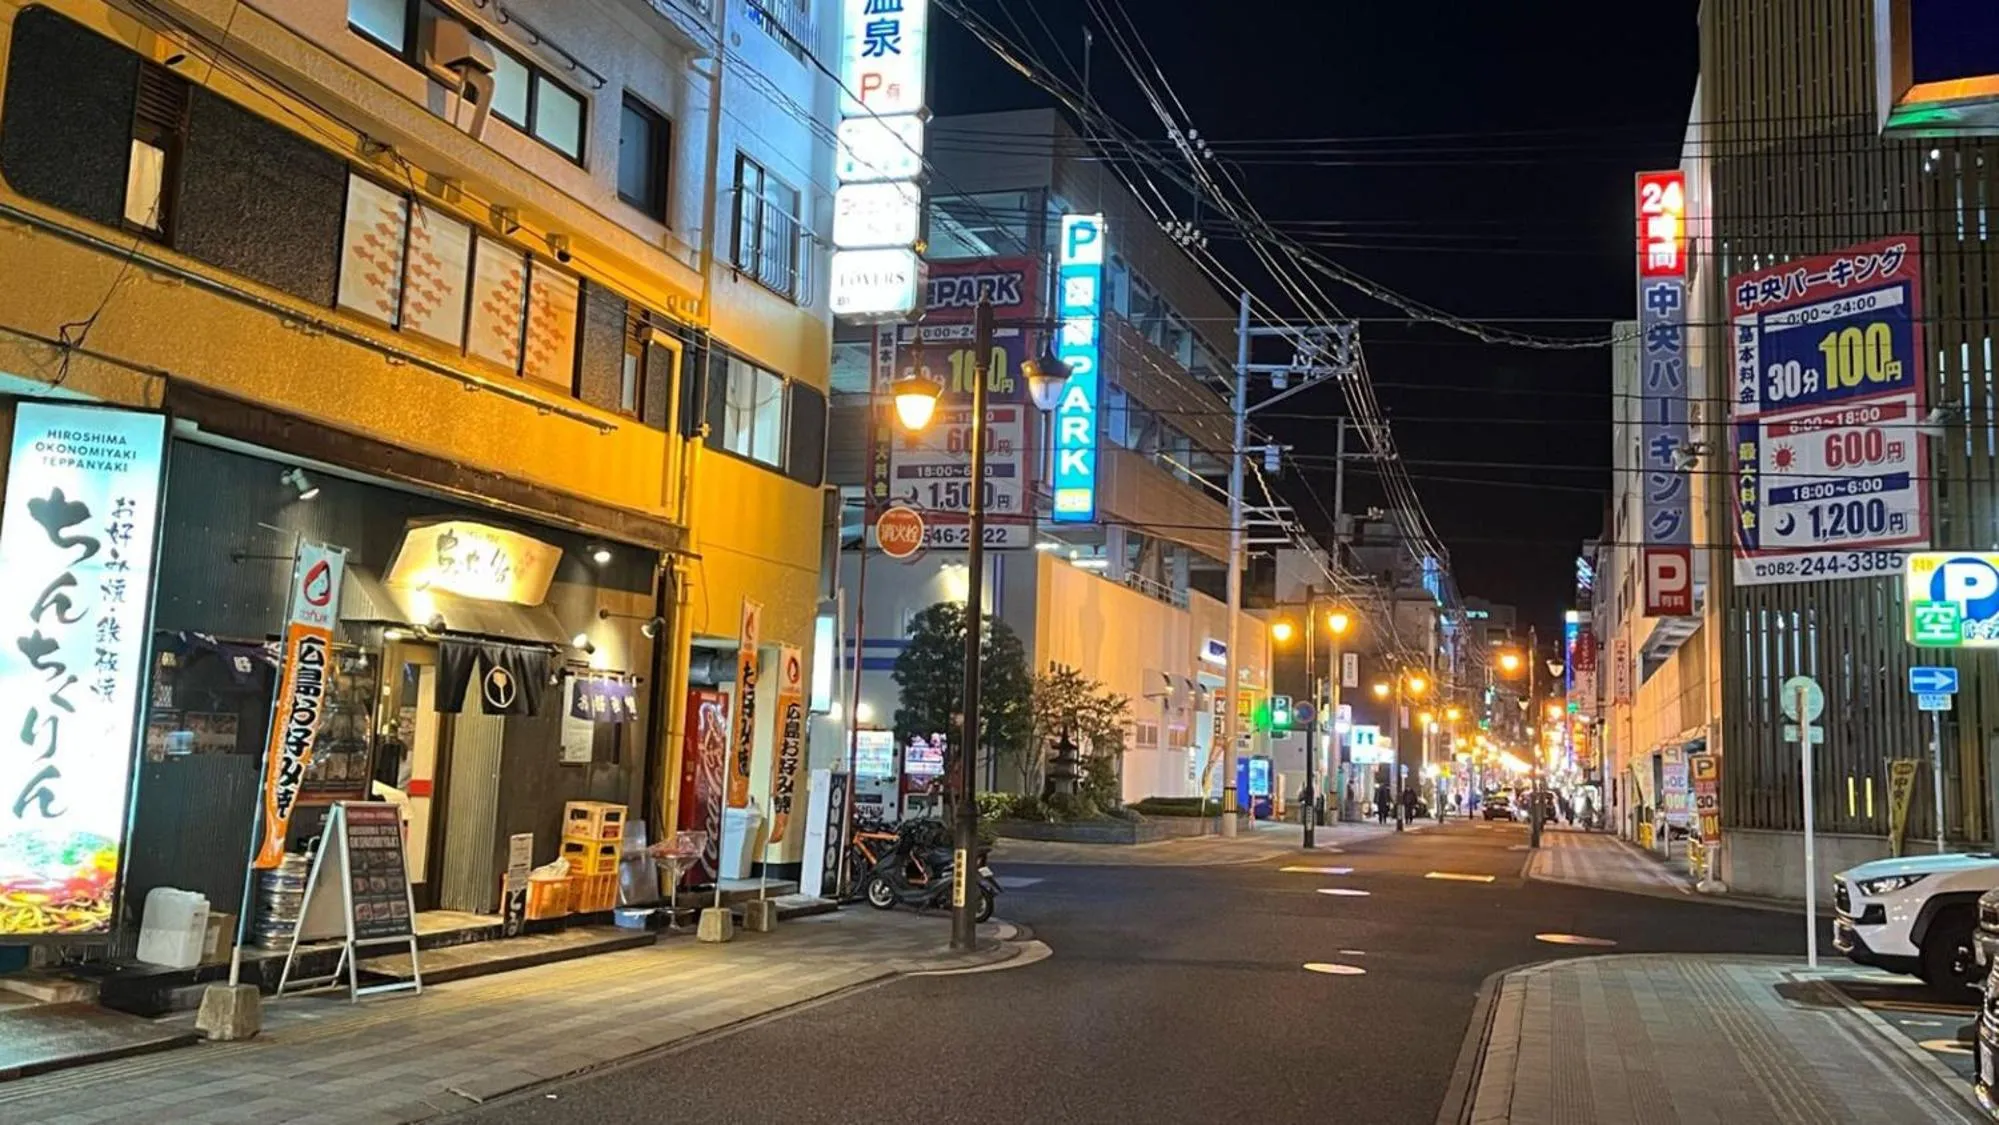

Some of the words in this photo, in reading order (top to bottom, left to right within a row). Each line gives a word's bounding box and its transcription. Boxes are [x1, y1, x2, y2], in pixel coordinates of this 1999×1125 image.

[861, 73, 883, 101] P
[1069, 222, 1097, 258] P
[1737, 245, 1906, 307] 中央パーキング
[1739, 324, 1755, 403] 基本料金
[1768, 361, 1819, 400] 30分
[1819, 324, 1902, 390] 100円
[1647, 284, 1682, 540] 中央パーキング
[35, 441, 137, 460] OKONOMIYAKI
[47, 429, 127, 446] HIROSHIMA
[1825, 430, 1905, 468] 600円
[42, 456, 128, 472] TEPPANYAKI
[917, 466, 993, 477] 18:00~60
[1740, 443, 1756, 528] 最大料金
[881, 524, 919, 542] 消火栓
[1809, 500, 1907, 540] 1,200円
[1649, 555, 1687, 607] P
[1768, 552, 1903, 576] 082-244-3385
[1944, 563, 1998, 618] P
[1915, 601, 1958, 640] 空
[12, 486, 101, 819] ちんちくりん
[1697, 760, 1713, 776] P
